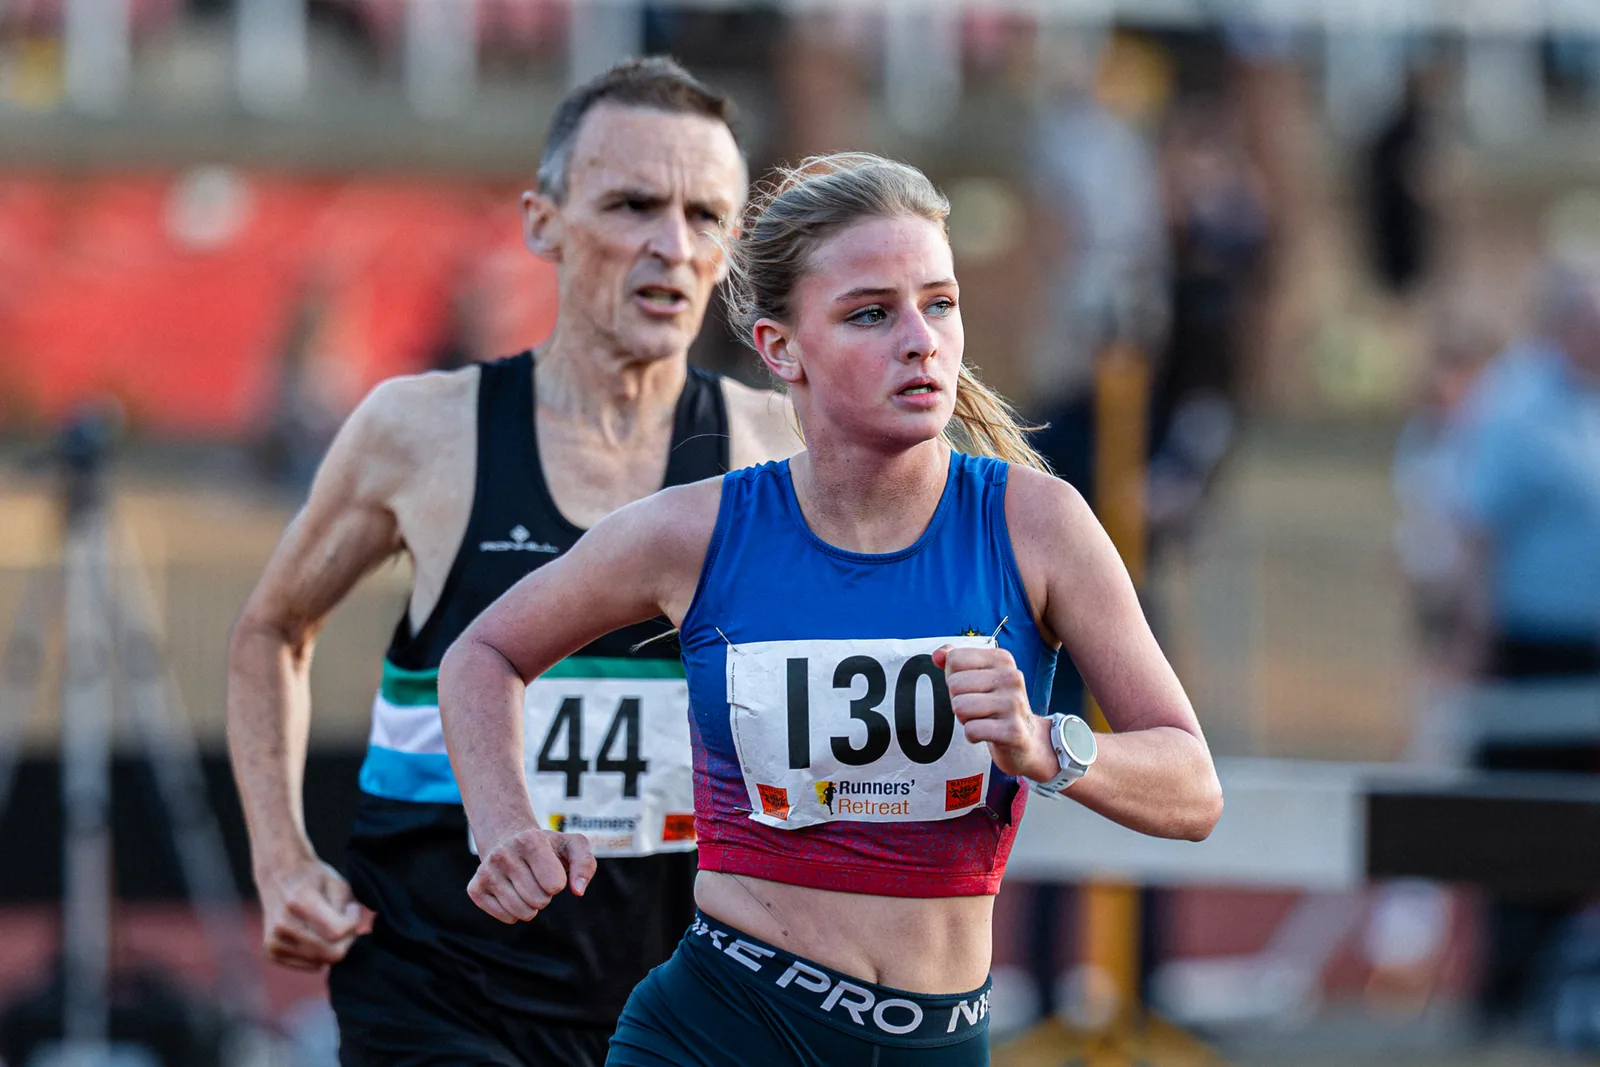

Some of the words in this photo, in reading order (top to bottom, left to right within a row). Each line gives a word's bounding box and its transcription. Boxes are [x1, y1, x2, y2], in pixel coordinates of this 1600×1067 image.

[536, 696, 649, 799] 44
[786, 653, 955, 770] 130
[838, 798, 909, 815] Retreat
[839, 779, 915, 795] Runners'
[775, 959, 924, 1035] PRO
